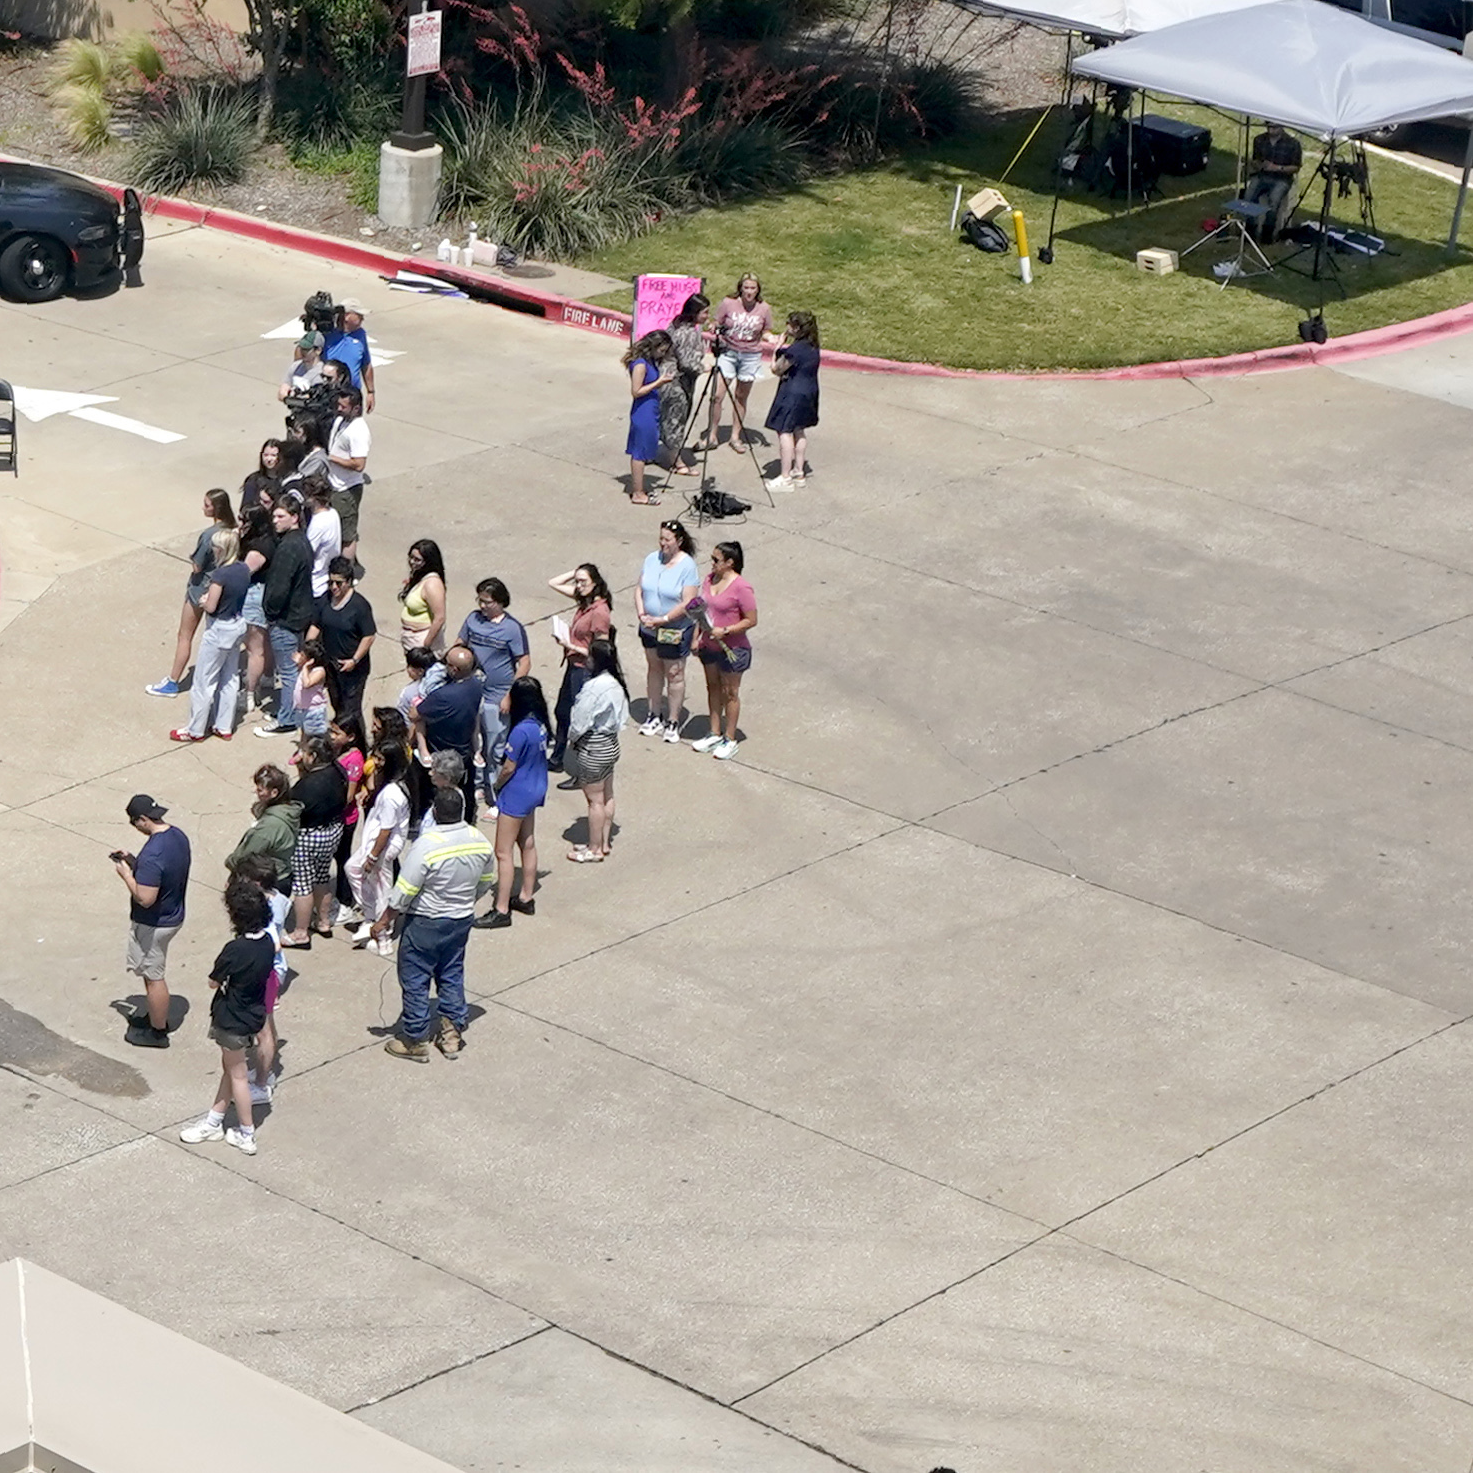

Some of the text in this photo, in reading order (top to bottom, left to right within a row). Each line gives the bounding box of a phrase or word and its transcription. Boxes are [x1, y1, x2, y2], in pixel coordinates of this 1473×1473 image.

[642, 279, 667, 291] FREE
[639, 301, 682, 316] PRAYE
[564, 307, 624, 336] FIRE LANE
